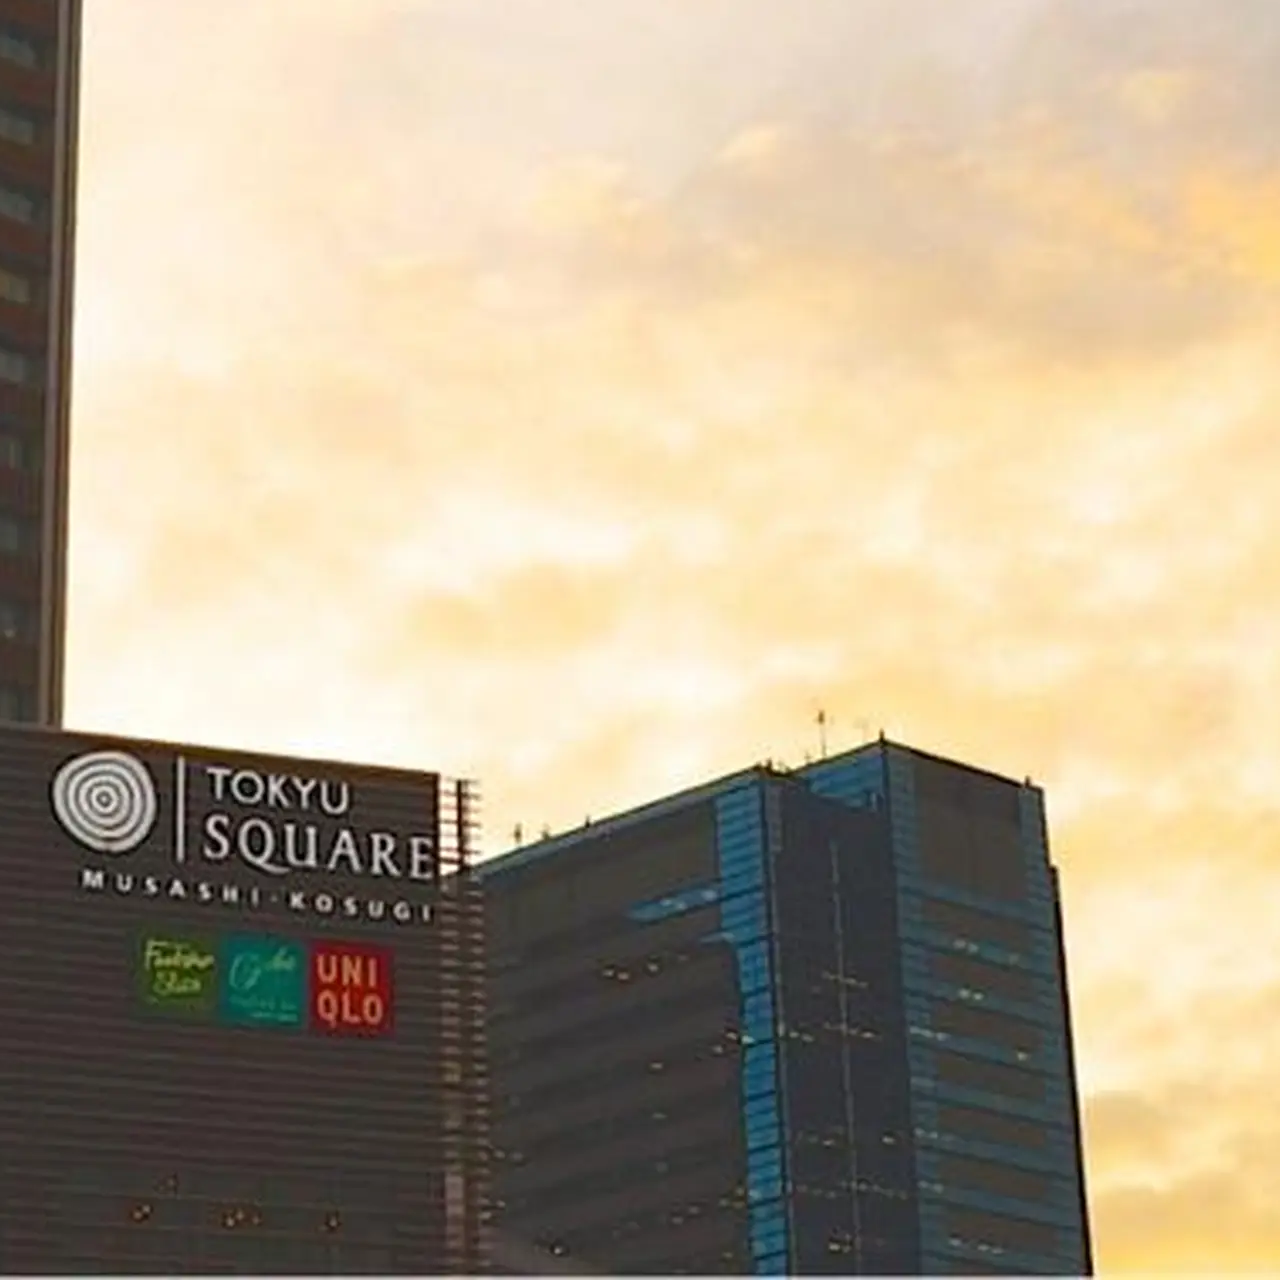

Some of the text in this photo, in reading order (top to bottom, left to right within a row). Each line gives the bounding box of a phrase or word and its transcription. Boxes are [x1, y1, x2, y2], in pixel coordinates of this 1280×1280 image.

[206, 766, 349, 815] TOKYU
[202, 814, 434, 879] SQUARE
[317, 954, 378, 988] UNI
[318, 989, 383, 1028] QLO
